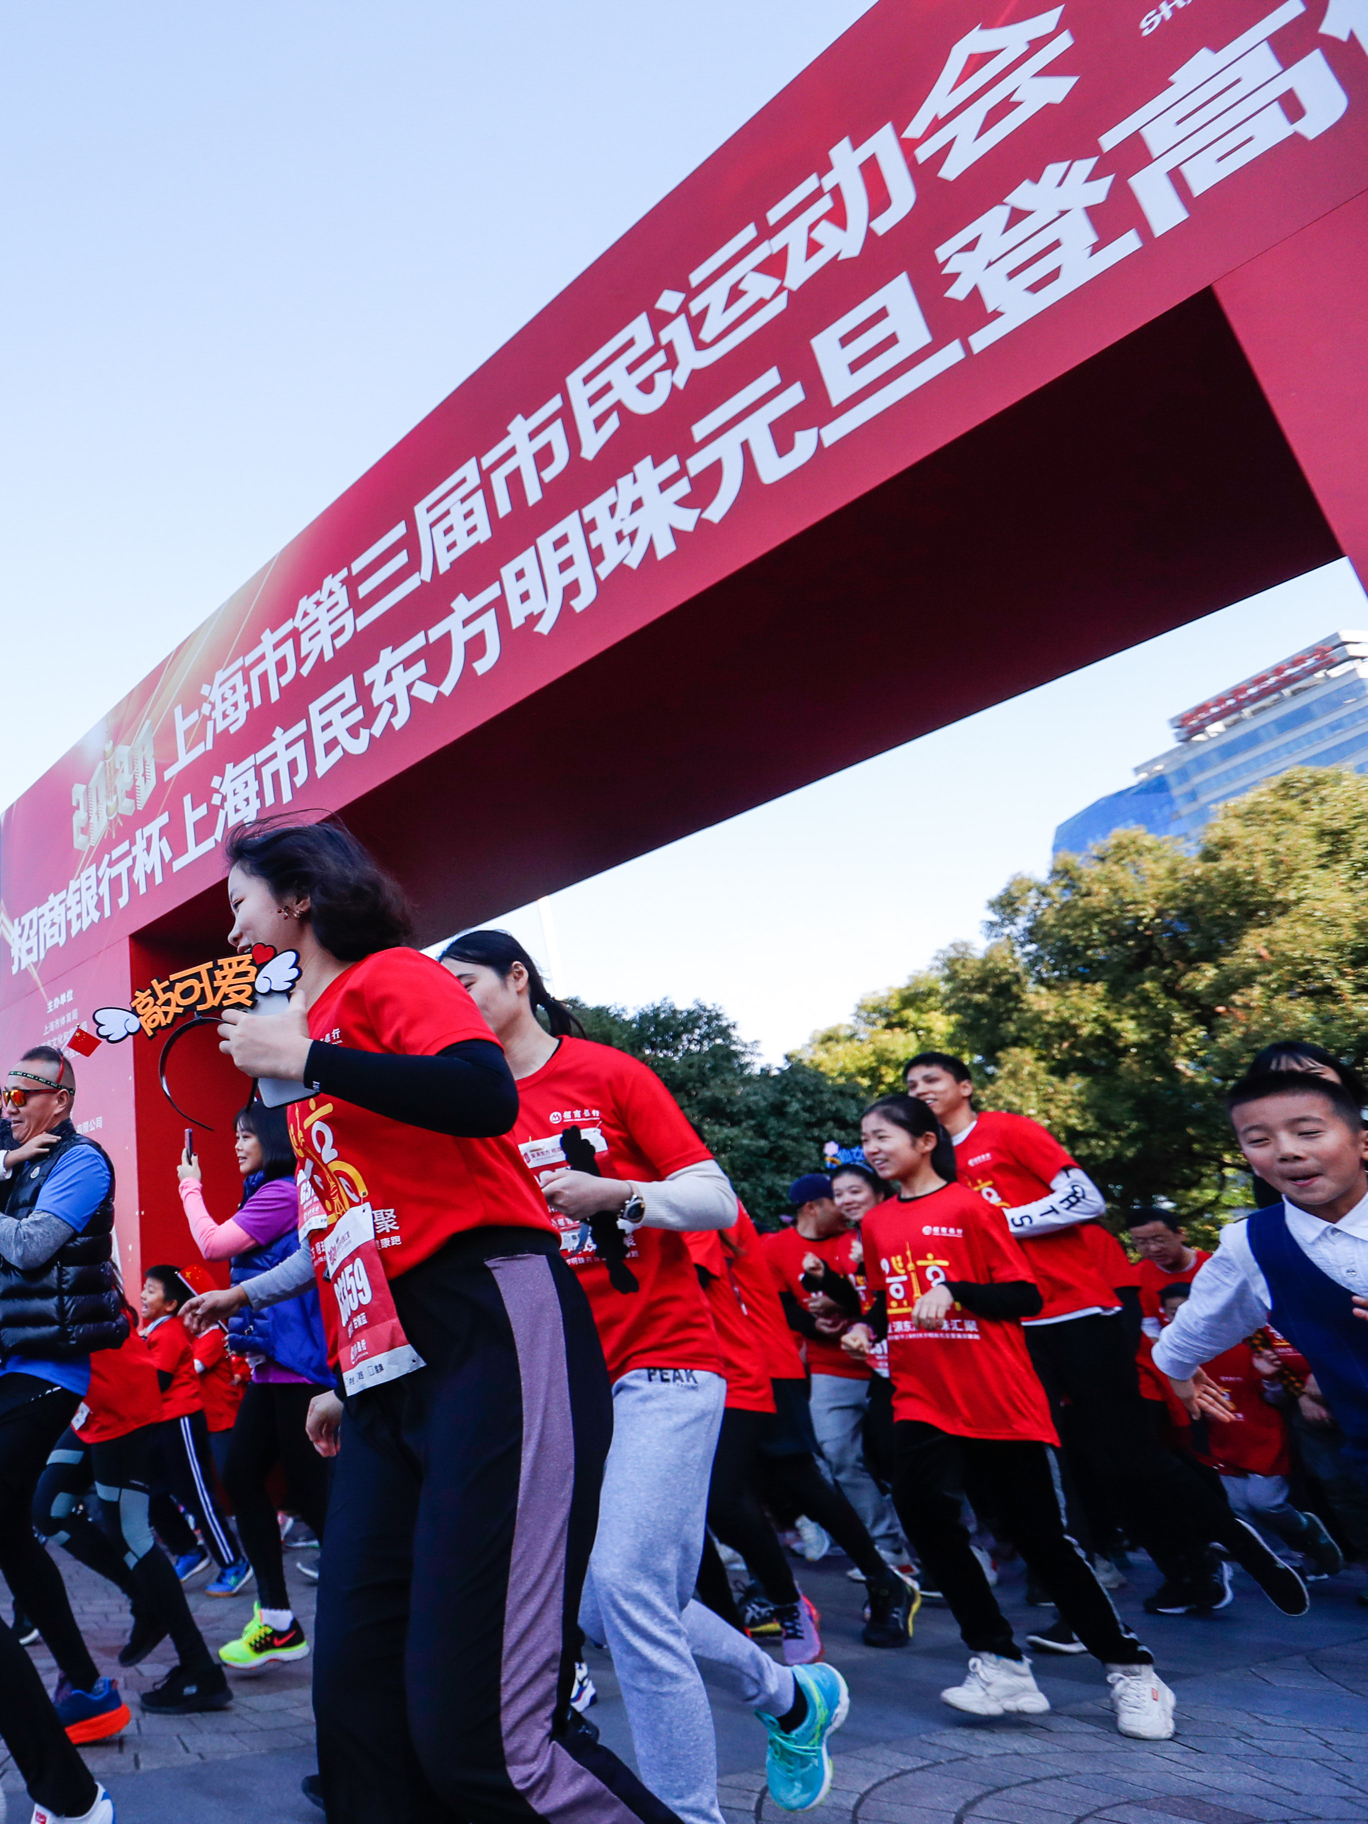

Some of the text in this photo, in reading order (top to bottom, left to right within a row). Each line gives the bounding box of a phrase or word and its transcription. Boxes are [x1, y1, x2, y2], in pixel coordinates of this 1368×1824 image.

[163, 3, 1081, 782] 上海市第三届市民运动会
[10, 0, 1368, 976] 招商银行杯上海市民东方明珠元旦登高
[46, 989, 74, 1014] 主办单位
[131, 953, 258, 1037] 敲可爱
[373, 1208, 400, 1234] 聚
[377, 1235, 402, 1250] 康跑
[646, 1368, 699, 1384] PEAK
